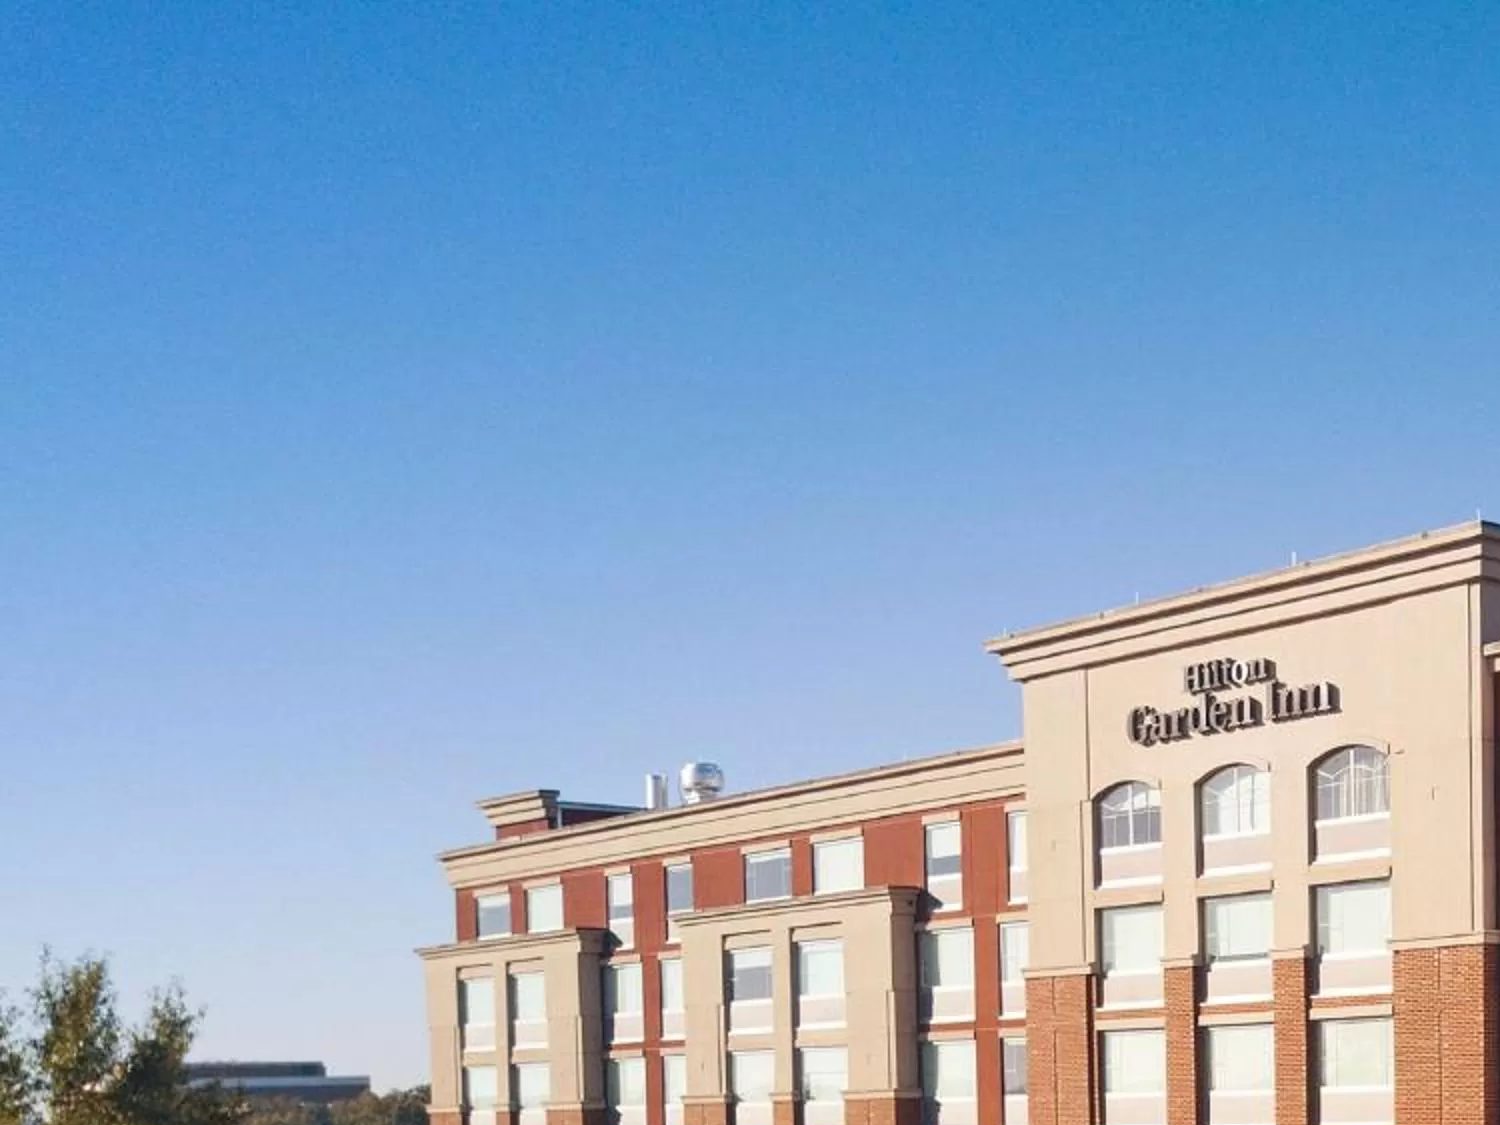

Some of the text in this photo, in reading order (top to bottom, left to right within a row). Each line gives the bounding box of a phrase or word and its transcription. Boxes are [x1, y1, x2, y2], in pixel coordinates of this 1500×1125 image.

[1185, 657, 1277, 694] Hilton
[1128, 681, 1342, 746] Garden Inn
